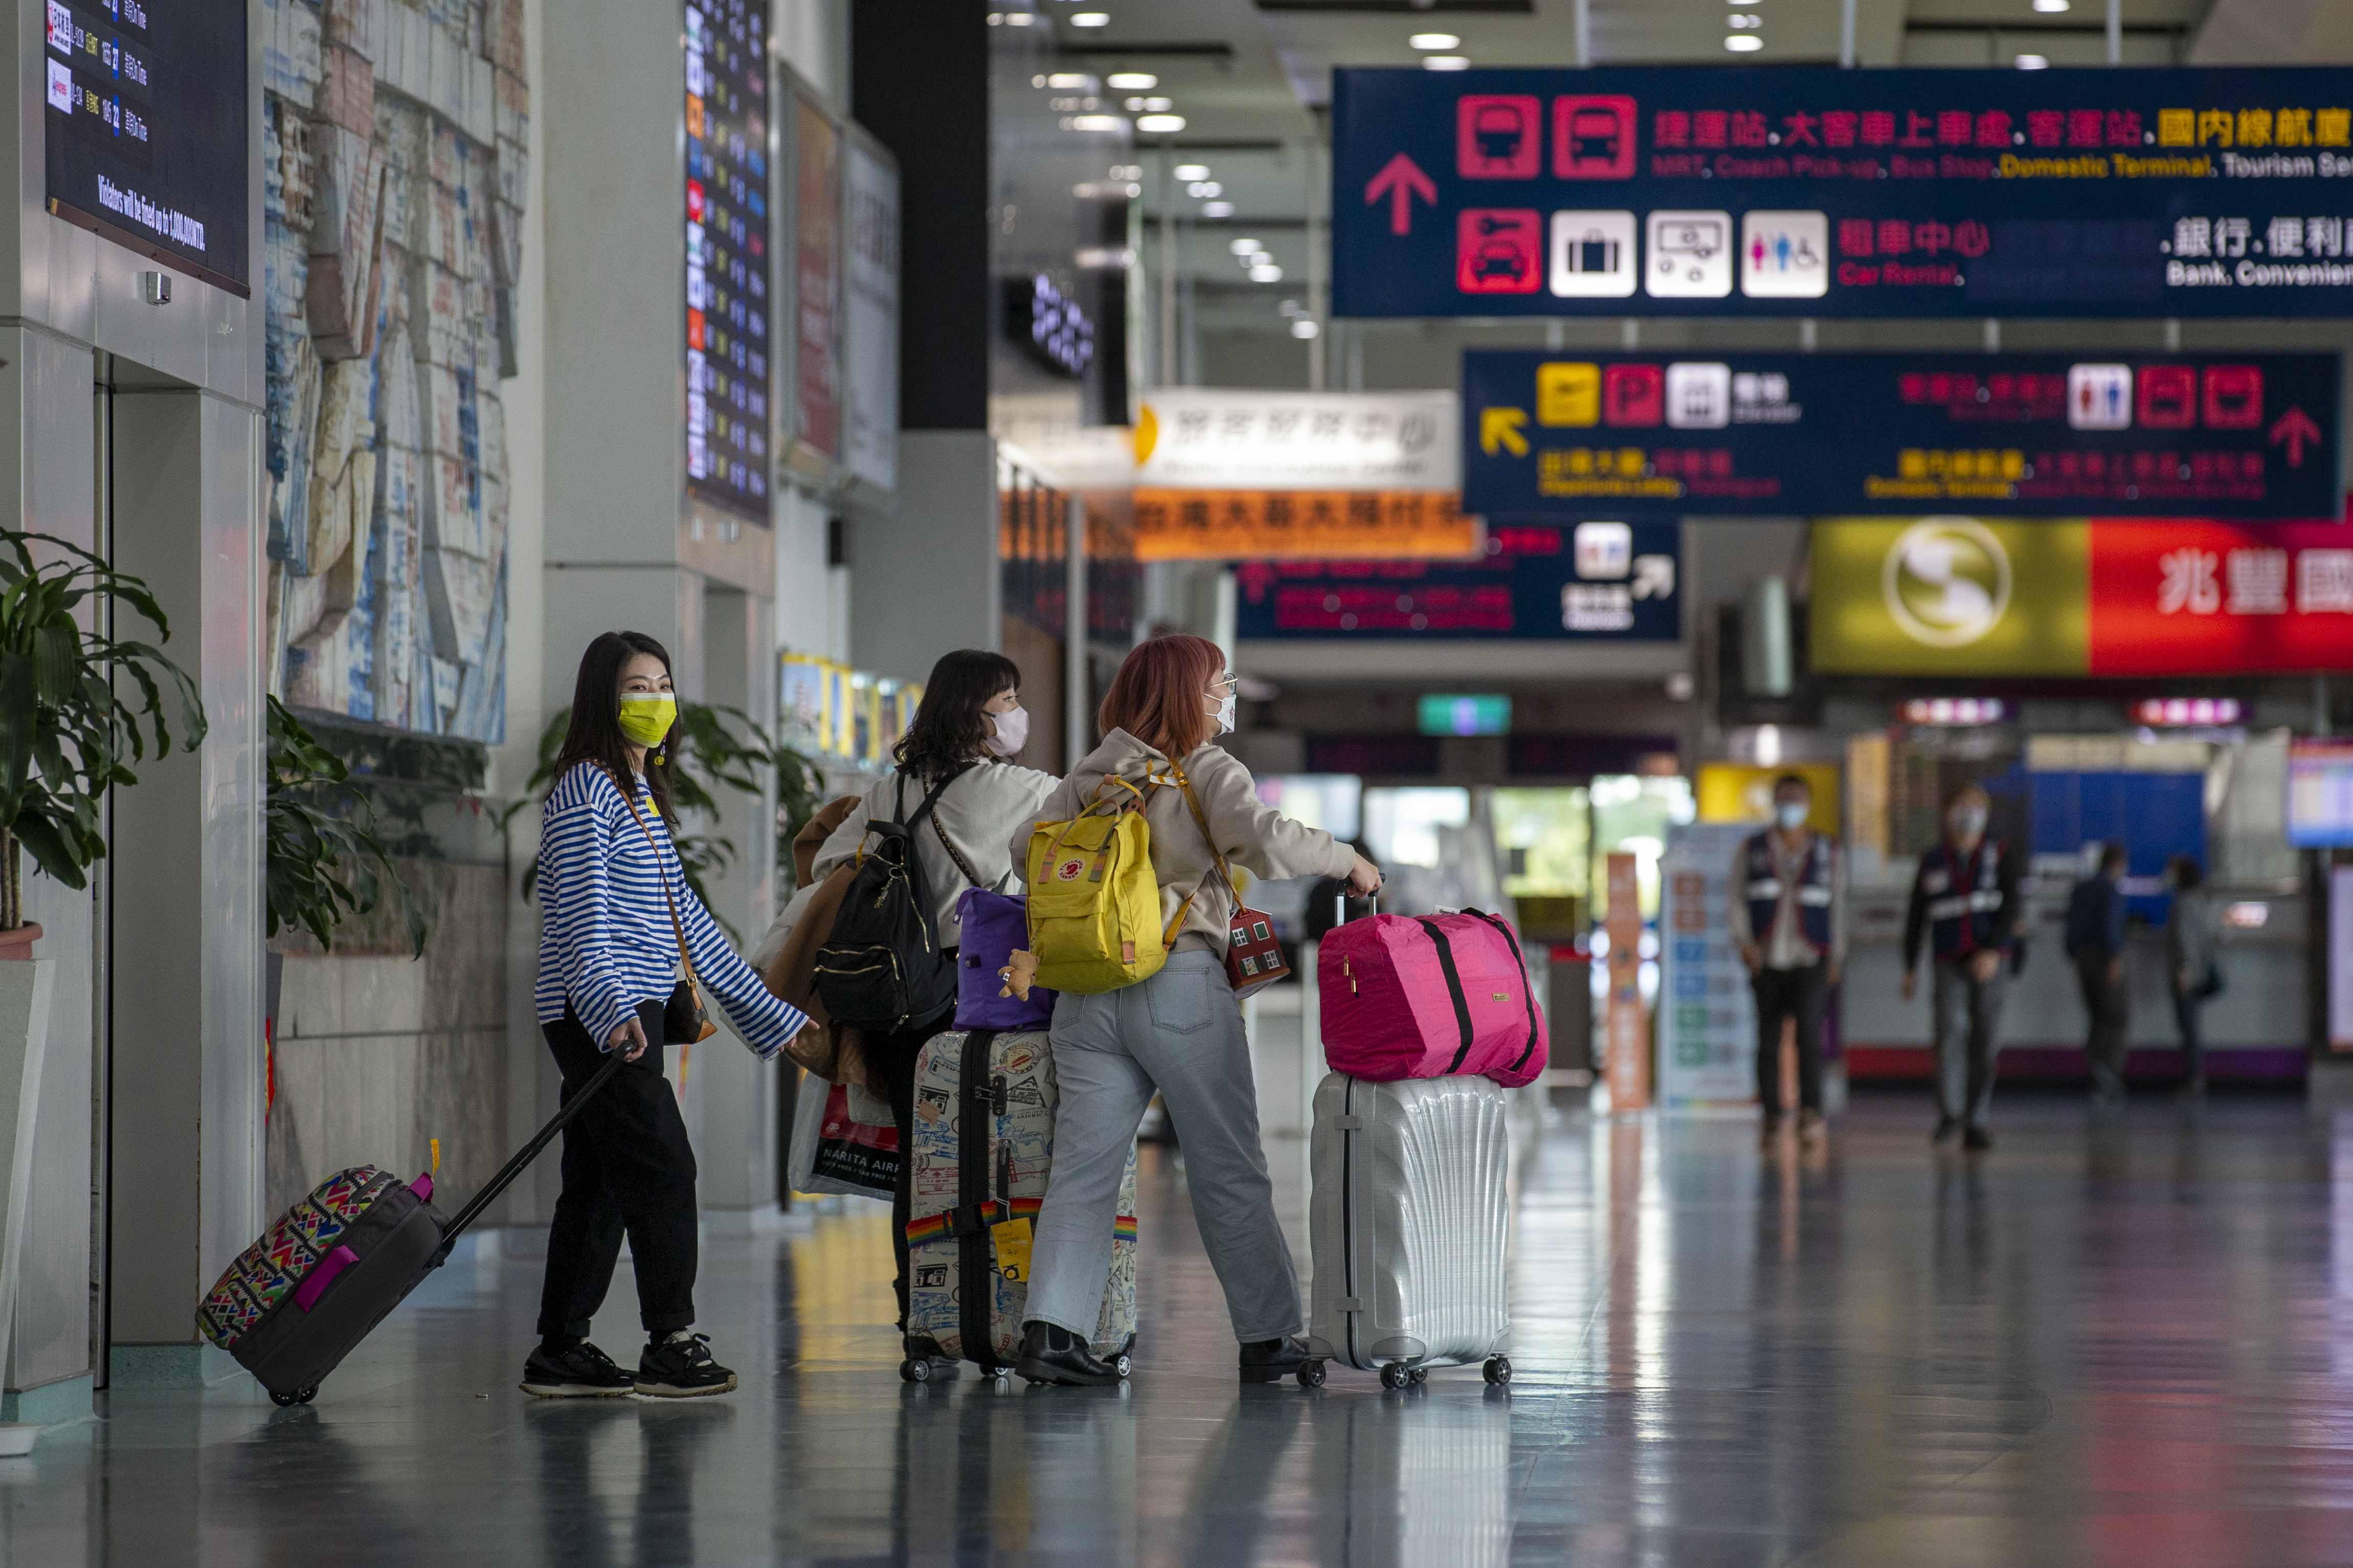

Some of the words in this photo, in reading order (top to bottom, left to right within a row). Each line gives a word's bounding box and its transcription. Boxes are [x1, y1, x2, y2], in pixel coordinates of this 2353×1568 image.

[2000, 154, 2109, 179] Domestic
[2221, 152, 2314, 177] Tourism
[134, 192, 141, 222] be
[823, 1148, 867, 1167] NARITA
[858, 1169, 870, 1177] TAX
[871, 1172, 886, 1180] FREE
